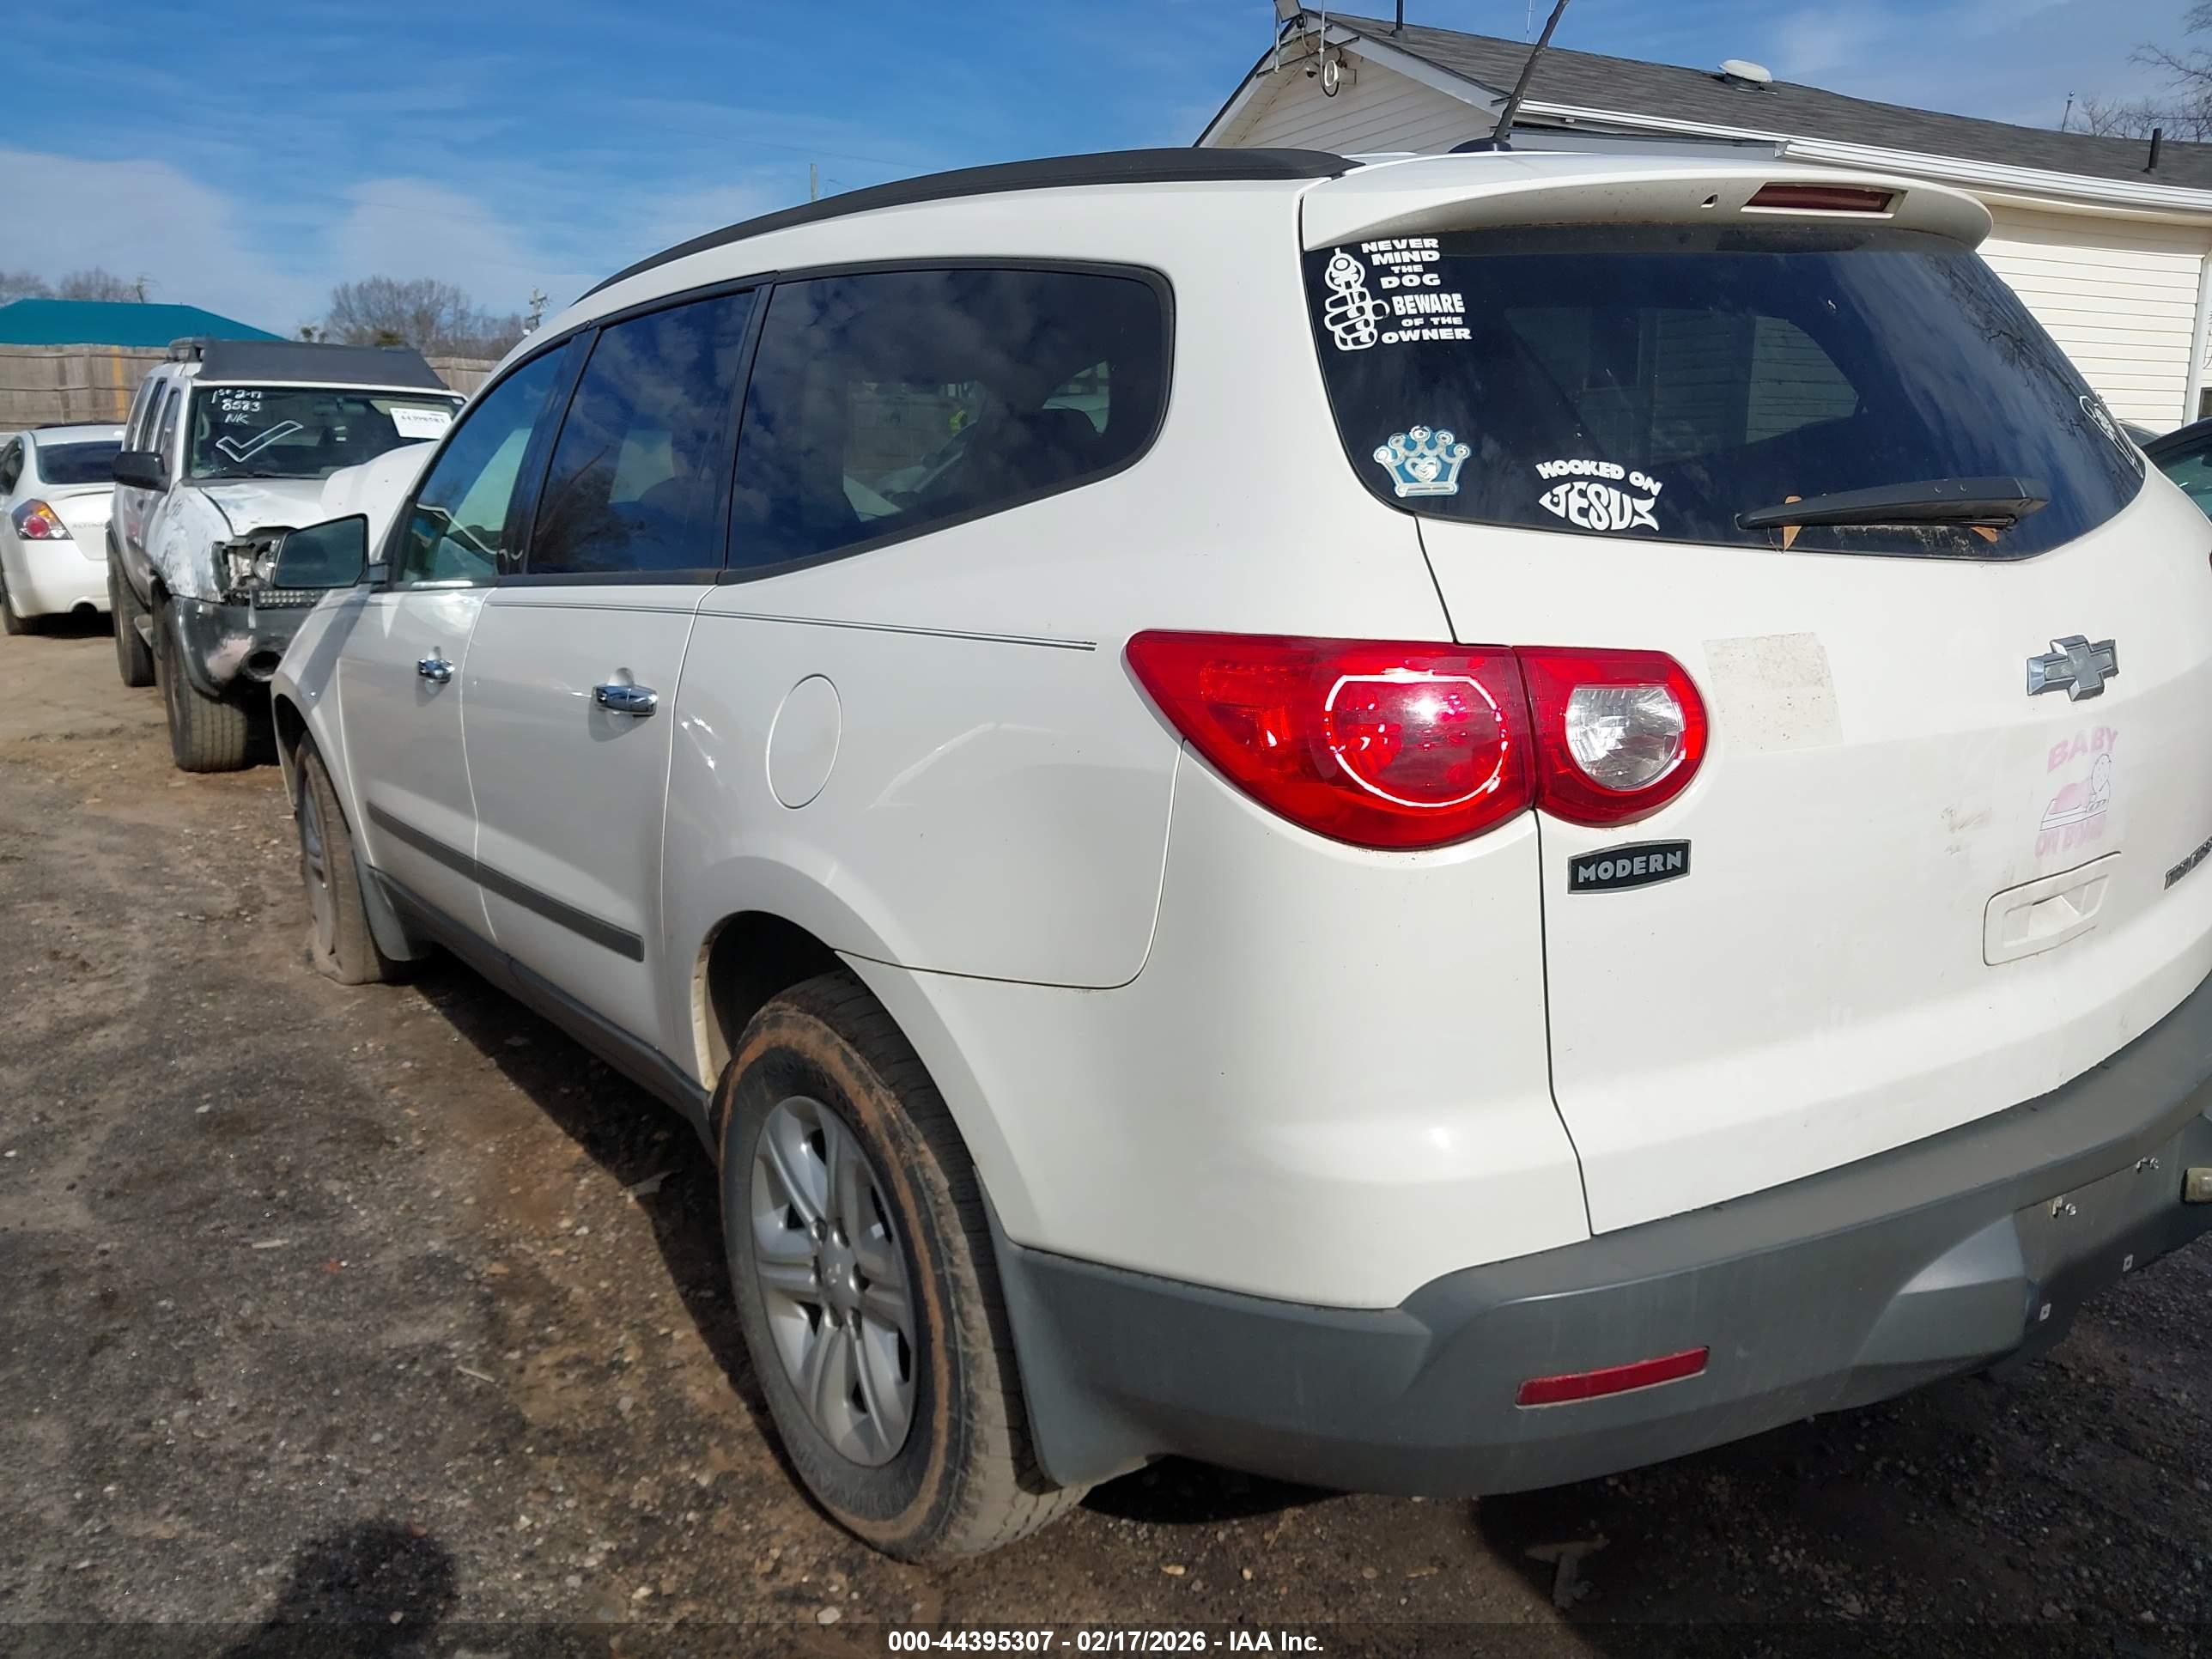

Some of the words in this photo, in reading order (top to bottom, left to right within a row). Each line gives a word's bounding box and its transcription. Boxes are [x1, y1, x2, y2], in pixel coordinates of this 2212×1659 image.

[1361, 238, 1439, 253] NEVER
[1371, 250, 1440, 266] MIND
[1390, 264, 1423, 274] THE
[1380, 273, 1441, 289] DOG
[1391, 293, 1465, 316] BEWARE
[1401, 318, 1425, 327] OF
[1430, 316, 1463, 325] THE
[1381, 328, 1472, 344] OWNER
[1535, 459, 1625, 480] HOOKED
[1628, 471, 1662, 496] ON
[1538, 481, 1660, 532] JESUS
[2047, 727, 2118, 774] BABY
[1578, 851, 1682, 883] MODERN
